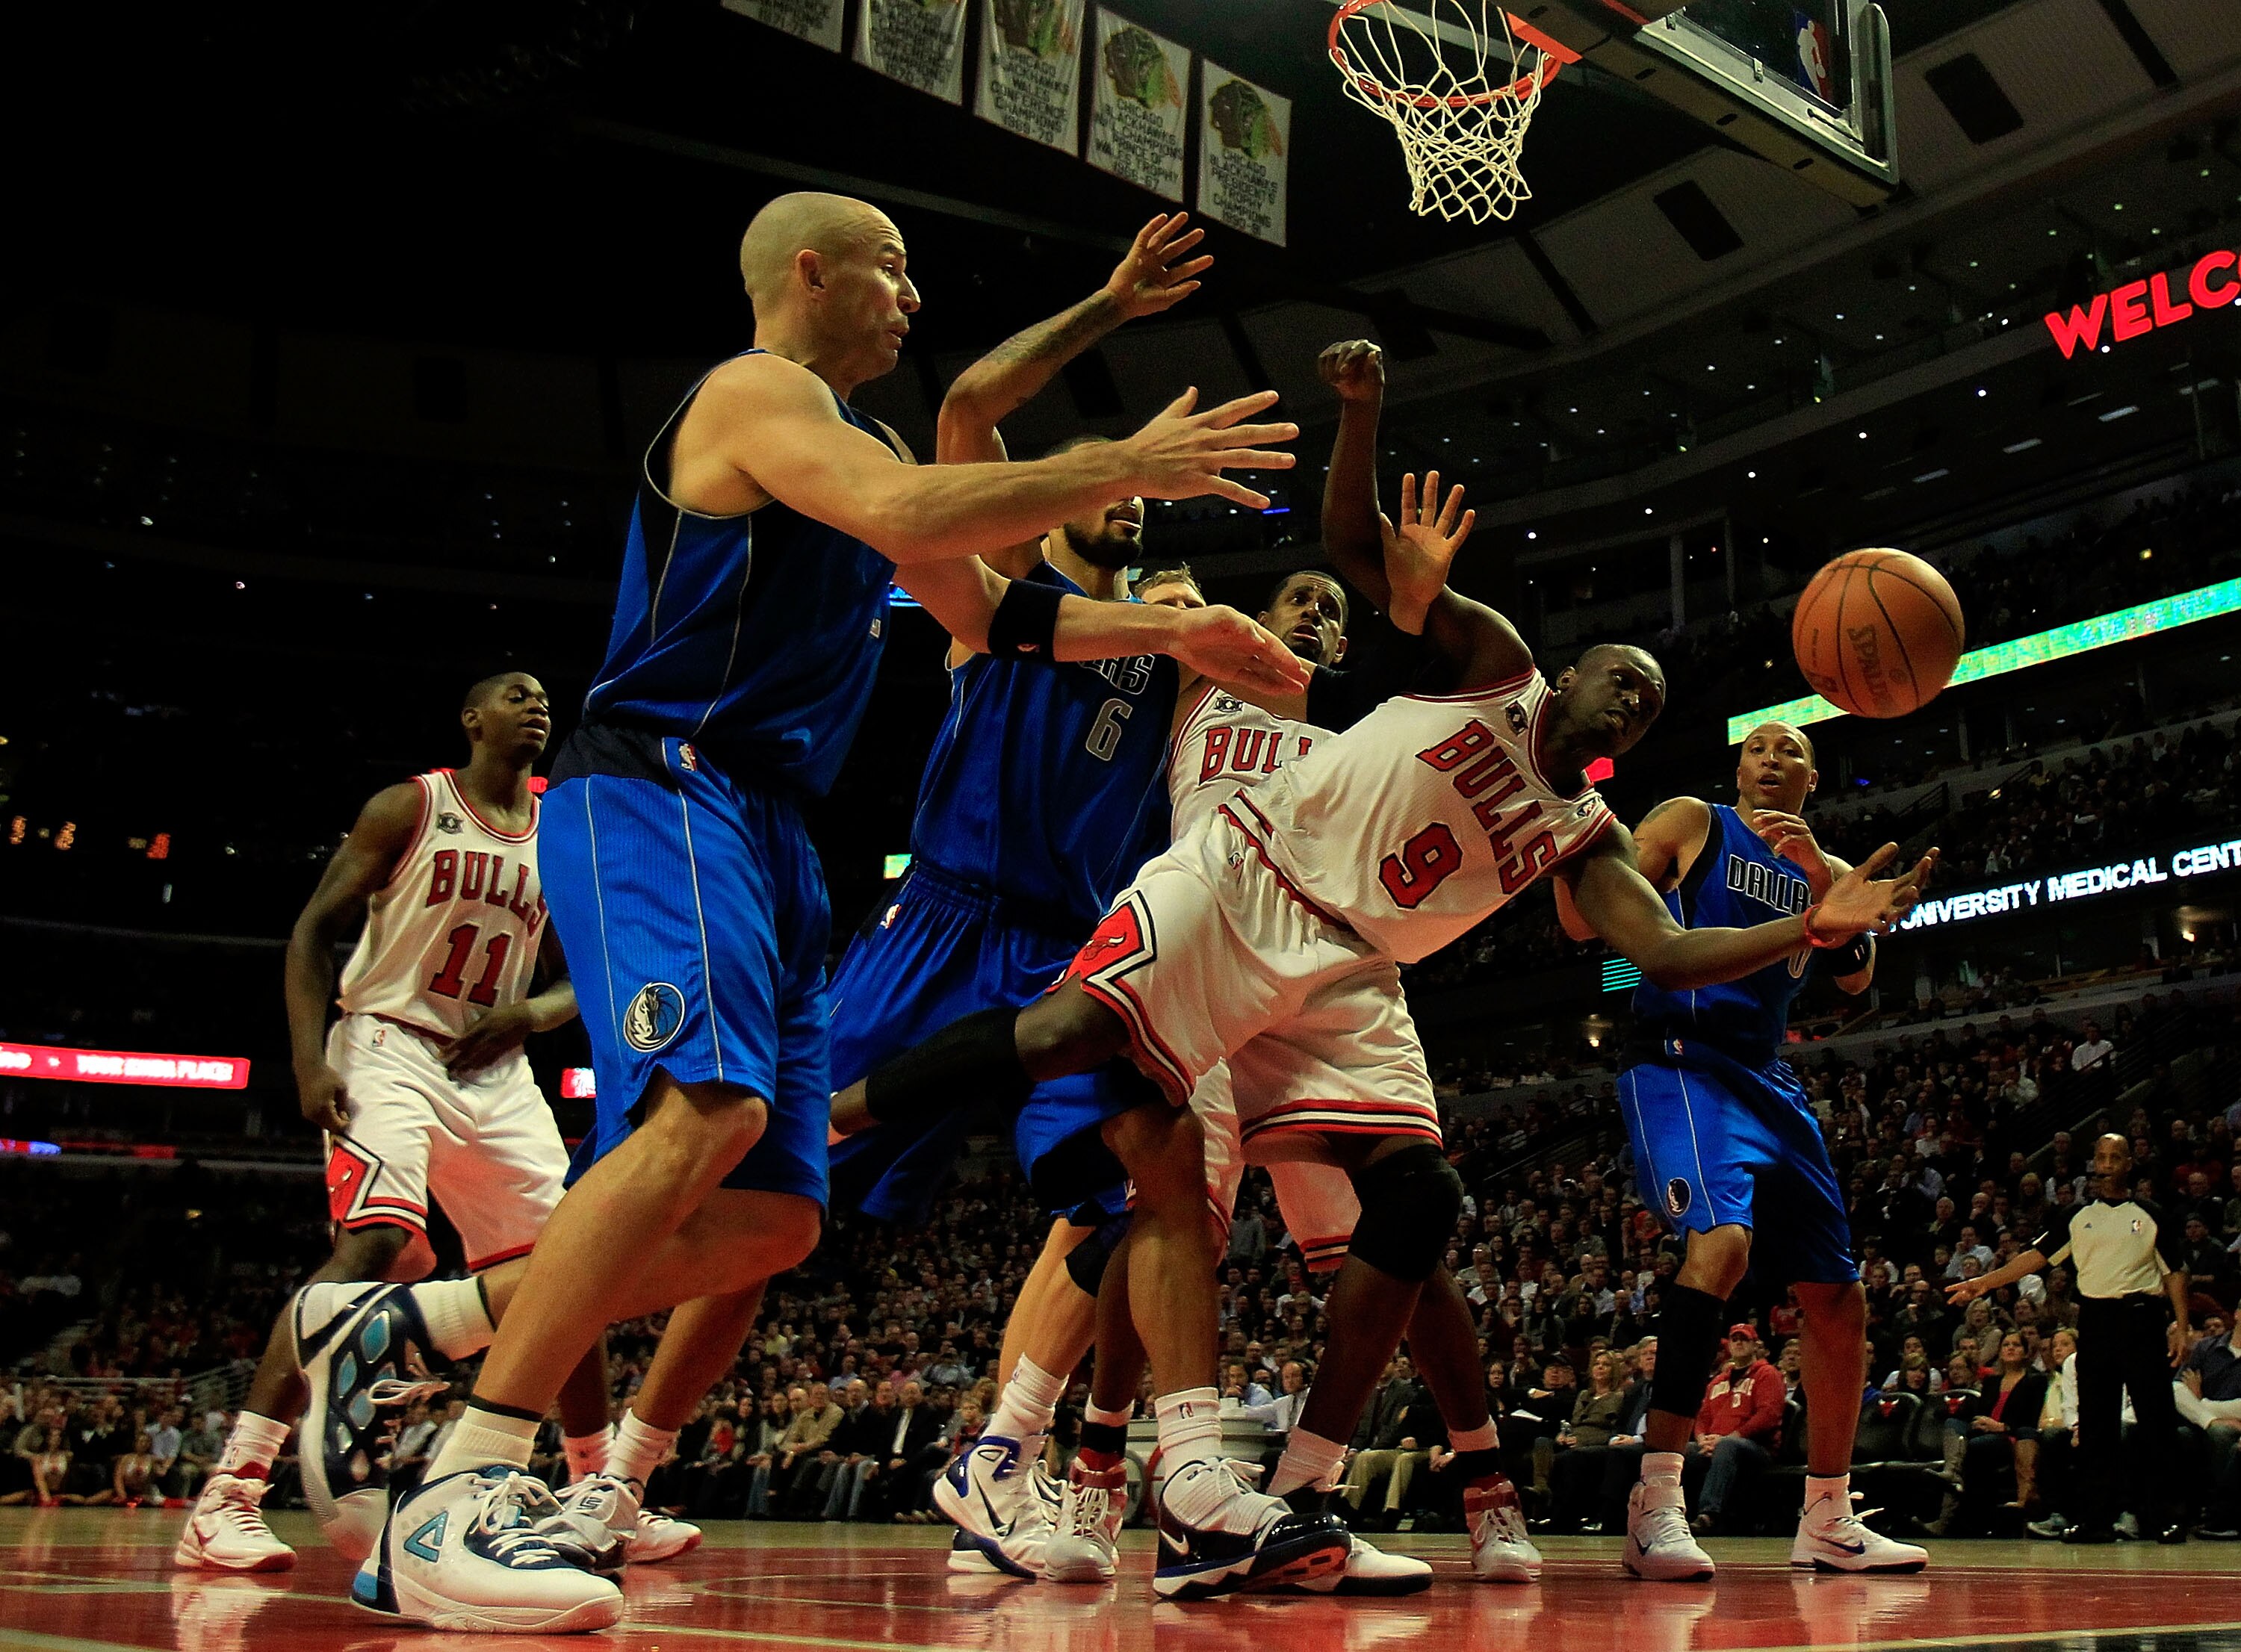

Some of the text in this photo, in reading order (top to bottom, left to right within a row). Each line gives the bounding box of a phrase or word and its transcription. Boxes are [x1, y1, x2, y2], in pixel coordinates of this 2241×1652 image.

[2044, 249, 2241, 360] WELC
[1086, 698, 1133, 761] 6
[1199, 727, 1312, 786] BUL
[1415, 719, 1560, 895] BULLS
[1379, 822, 1463, 910] 9
[1727, 854, 1812, 916] DALLA
[2047, 857, 2168, 901] MEDICAL
[428, 923, 514, 1007] 11
